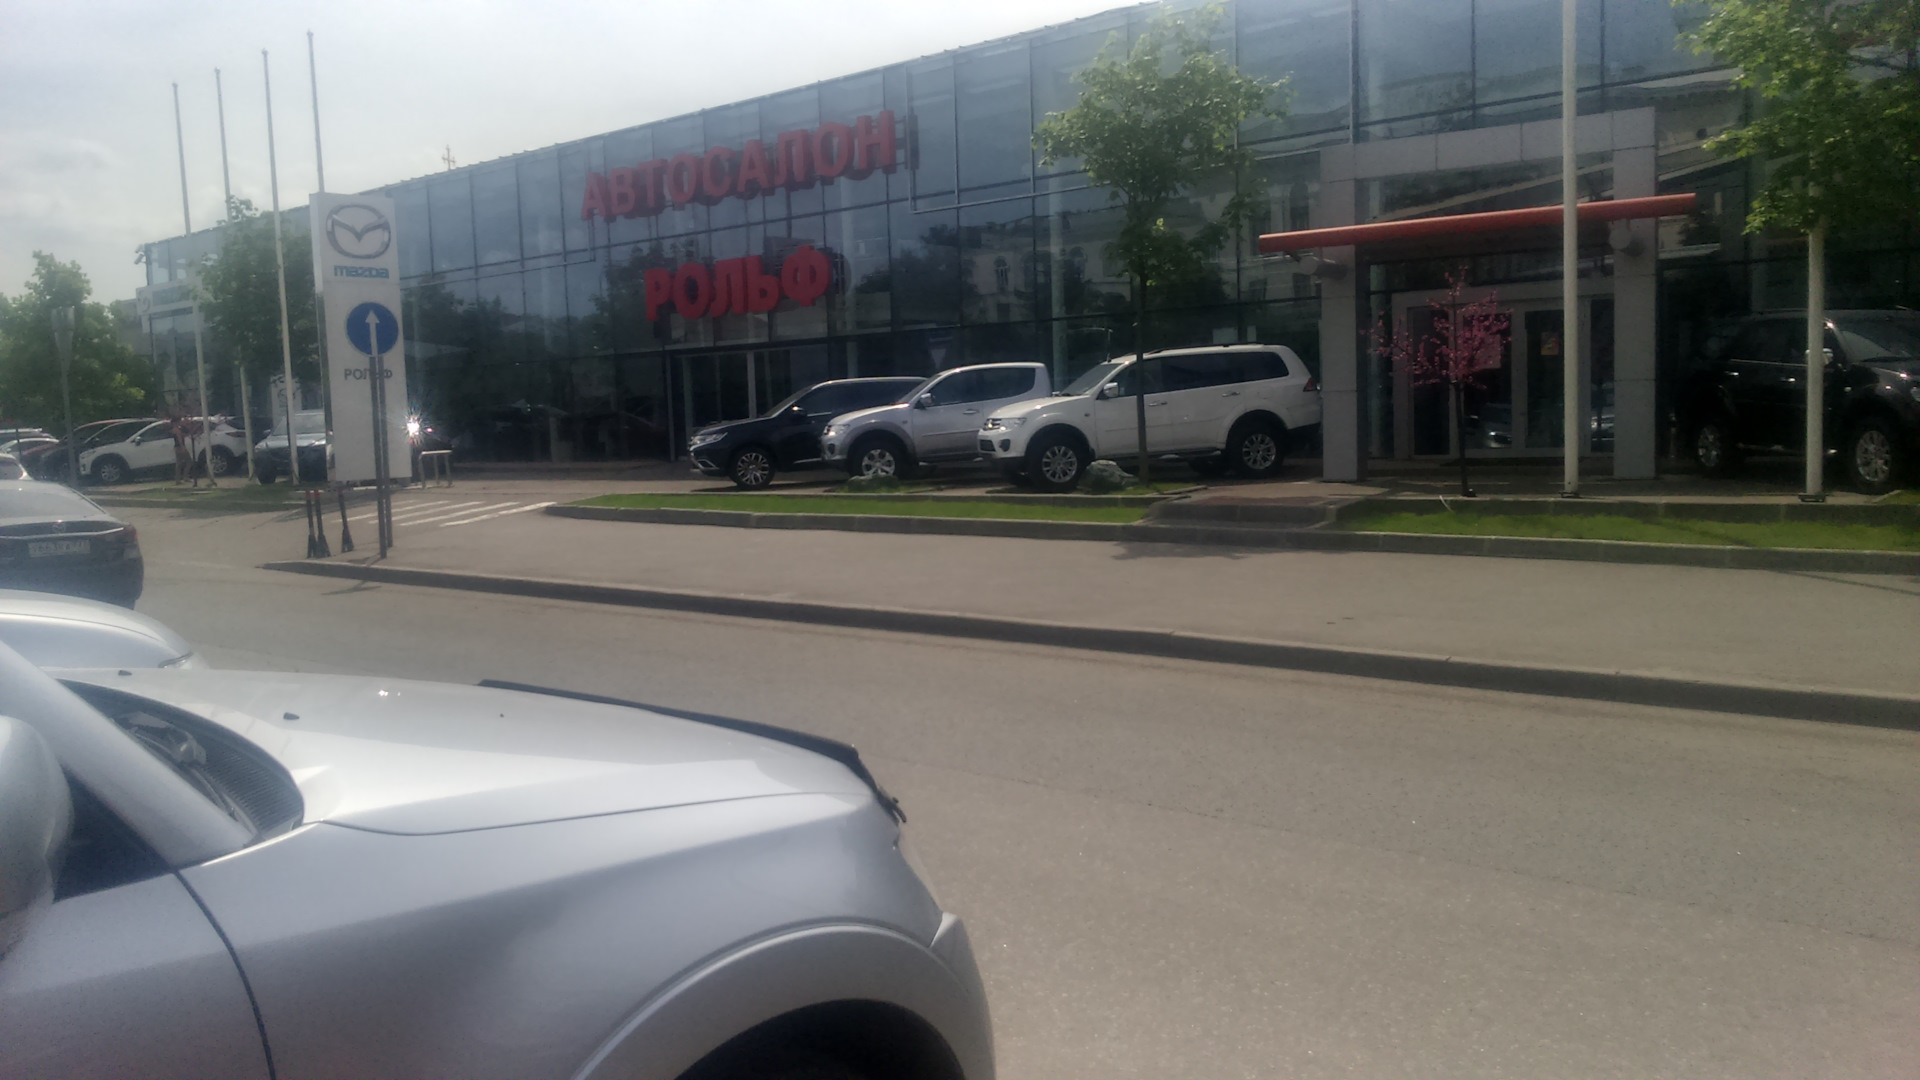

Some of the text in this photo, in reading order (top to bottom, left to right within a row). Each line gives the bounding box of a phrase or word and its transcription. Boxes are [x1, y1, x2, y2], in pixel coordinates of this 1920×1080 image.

[581, 110, 897, 222] АВТОСАЛОН
[644, 245, 831, 322] РОЛЬФ
[344, 368, 393, 381] РОЛФ
